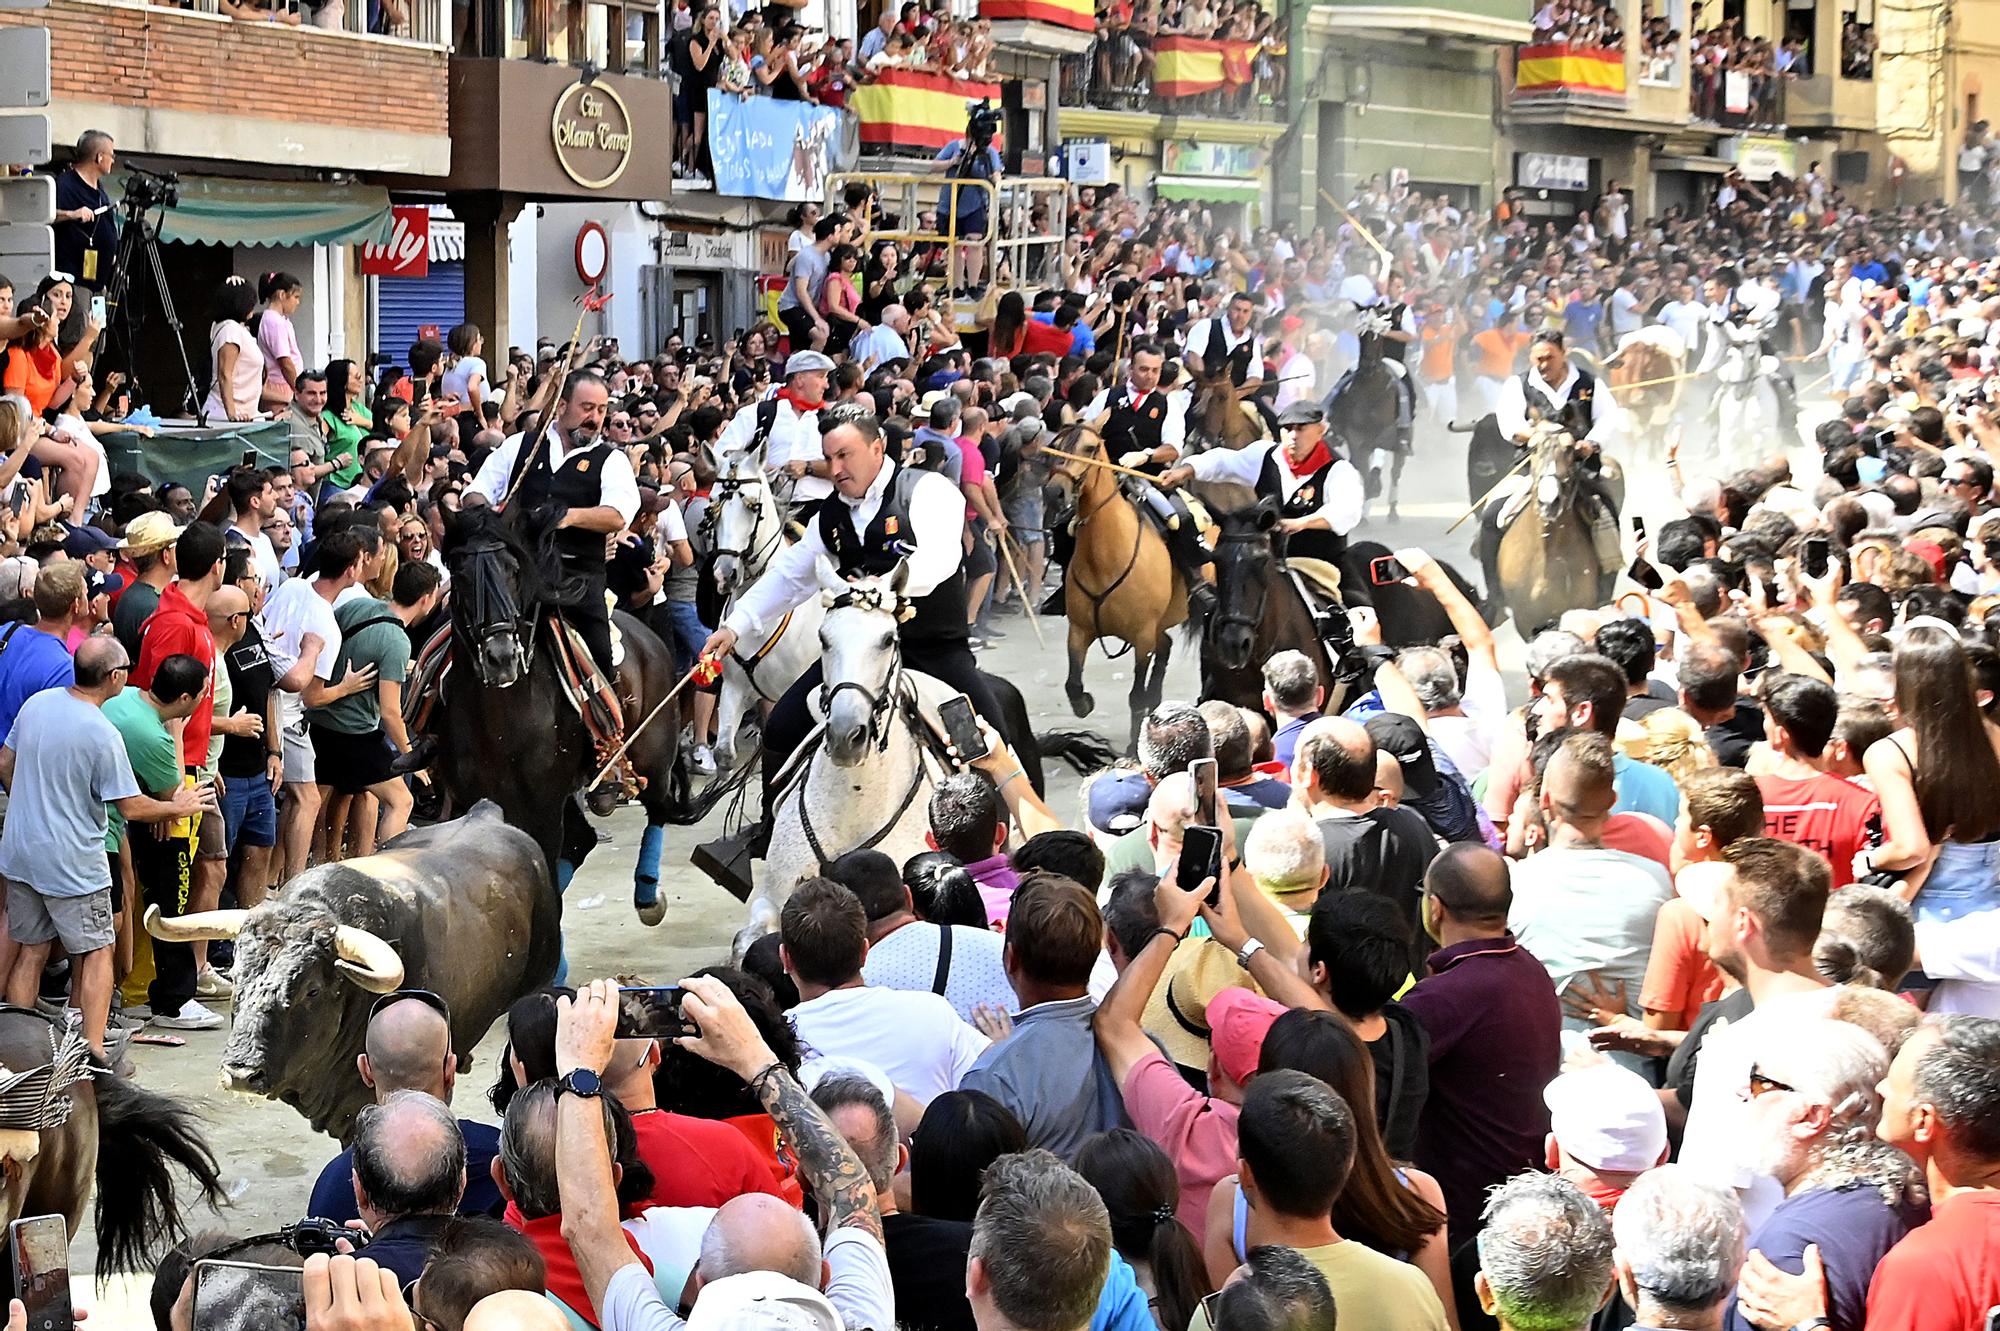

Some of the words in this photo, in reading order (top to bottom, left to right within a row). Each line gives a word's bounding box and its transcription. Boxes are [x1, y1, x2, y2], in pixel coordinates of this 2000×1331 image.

[580, 92, 603, 117] Casa
[559, 119, 595, 149] Mauro
[597, 122, 630, 152] Torres
